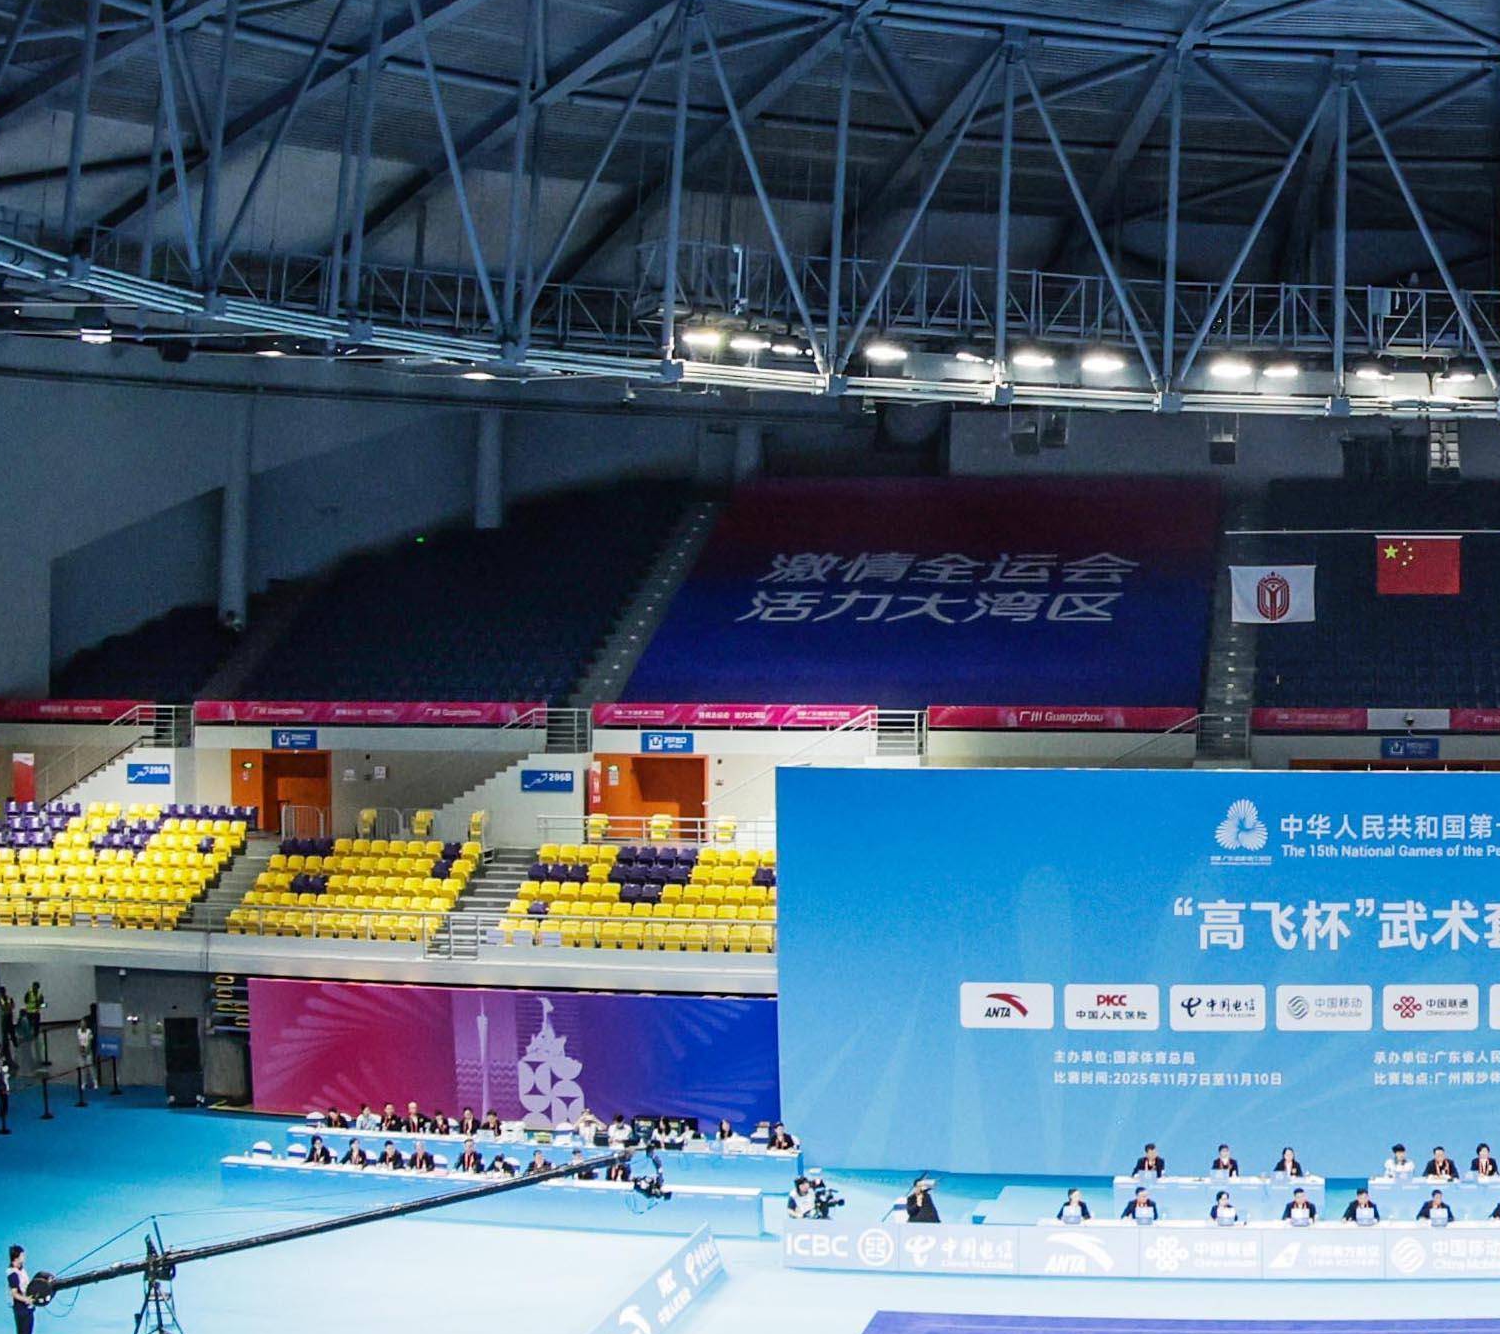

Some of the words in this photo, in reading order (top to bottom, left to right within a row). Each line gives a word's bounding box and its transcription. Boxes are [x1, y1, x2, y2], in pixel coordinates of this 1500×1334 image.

[757, 552, 1139, 583] 激情全运会
[734, 591, 1125, 623] 活力大湾区
[1045, 711, 1104, 723] Guangzhou
[1281, 844, 1305, 859] The
[1309, 844, 1338, 859] 15th
[1341, 844, 1395, 859] National
[1399, 844, 1444, 859] Games
[1447, 844, 1463, 859] of
[1465, 844, 1484, 859] the
[1096, 994, 1127, 1007] PICC
[1206, 995, 1256, 1012] 中国电信
[1315, 996, 1363, 1009] 中国移动
[1426, 998, 1469, 1009] 中国联通
[984, 1007, 1012, 1019] ANTA
[1075, 1009, 1148, 1021] 中国人民保险
[785, 1234, 849, 1257] ICBC
[1045, 1253, 1089, 1273] ANTA
